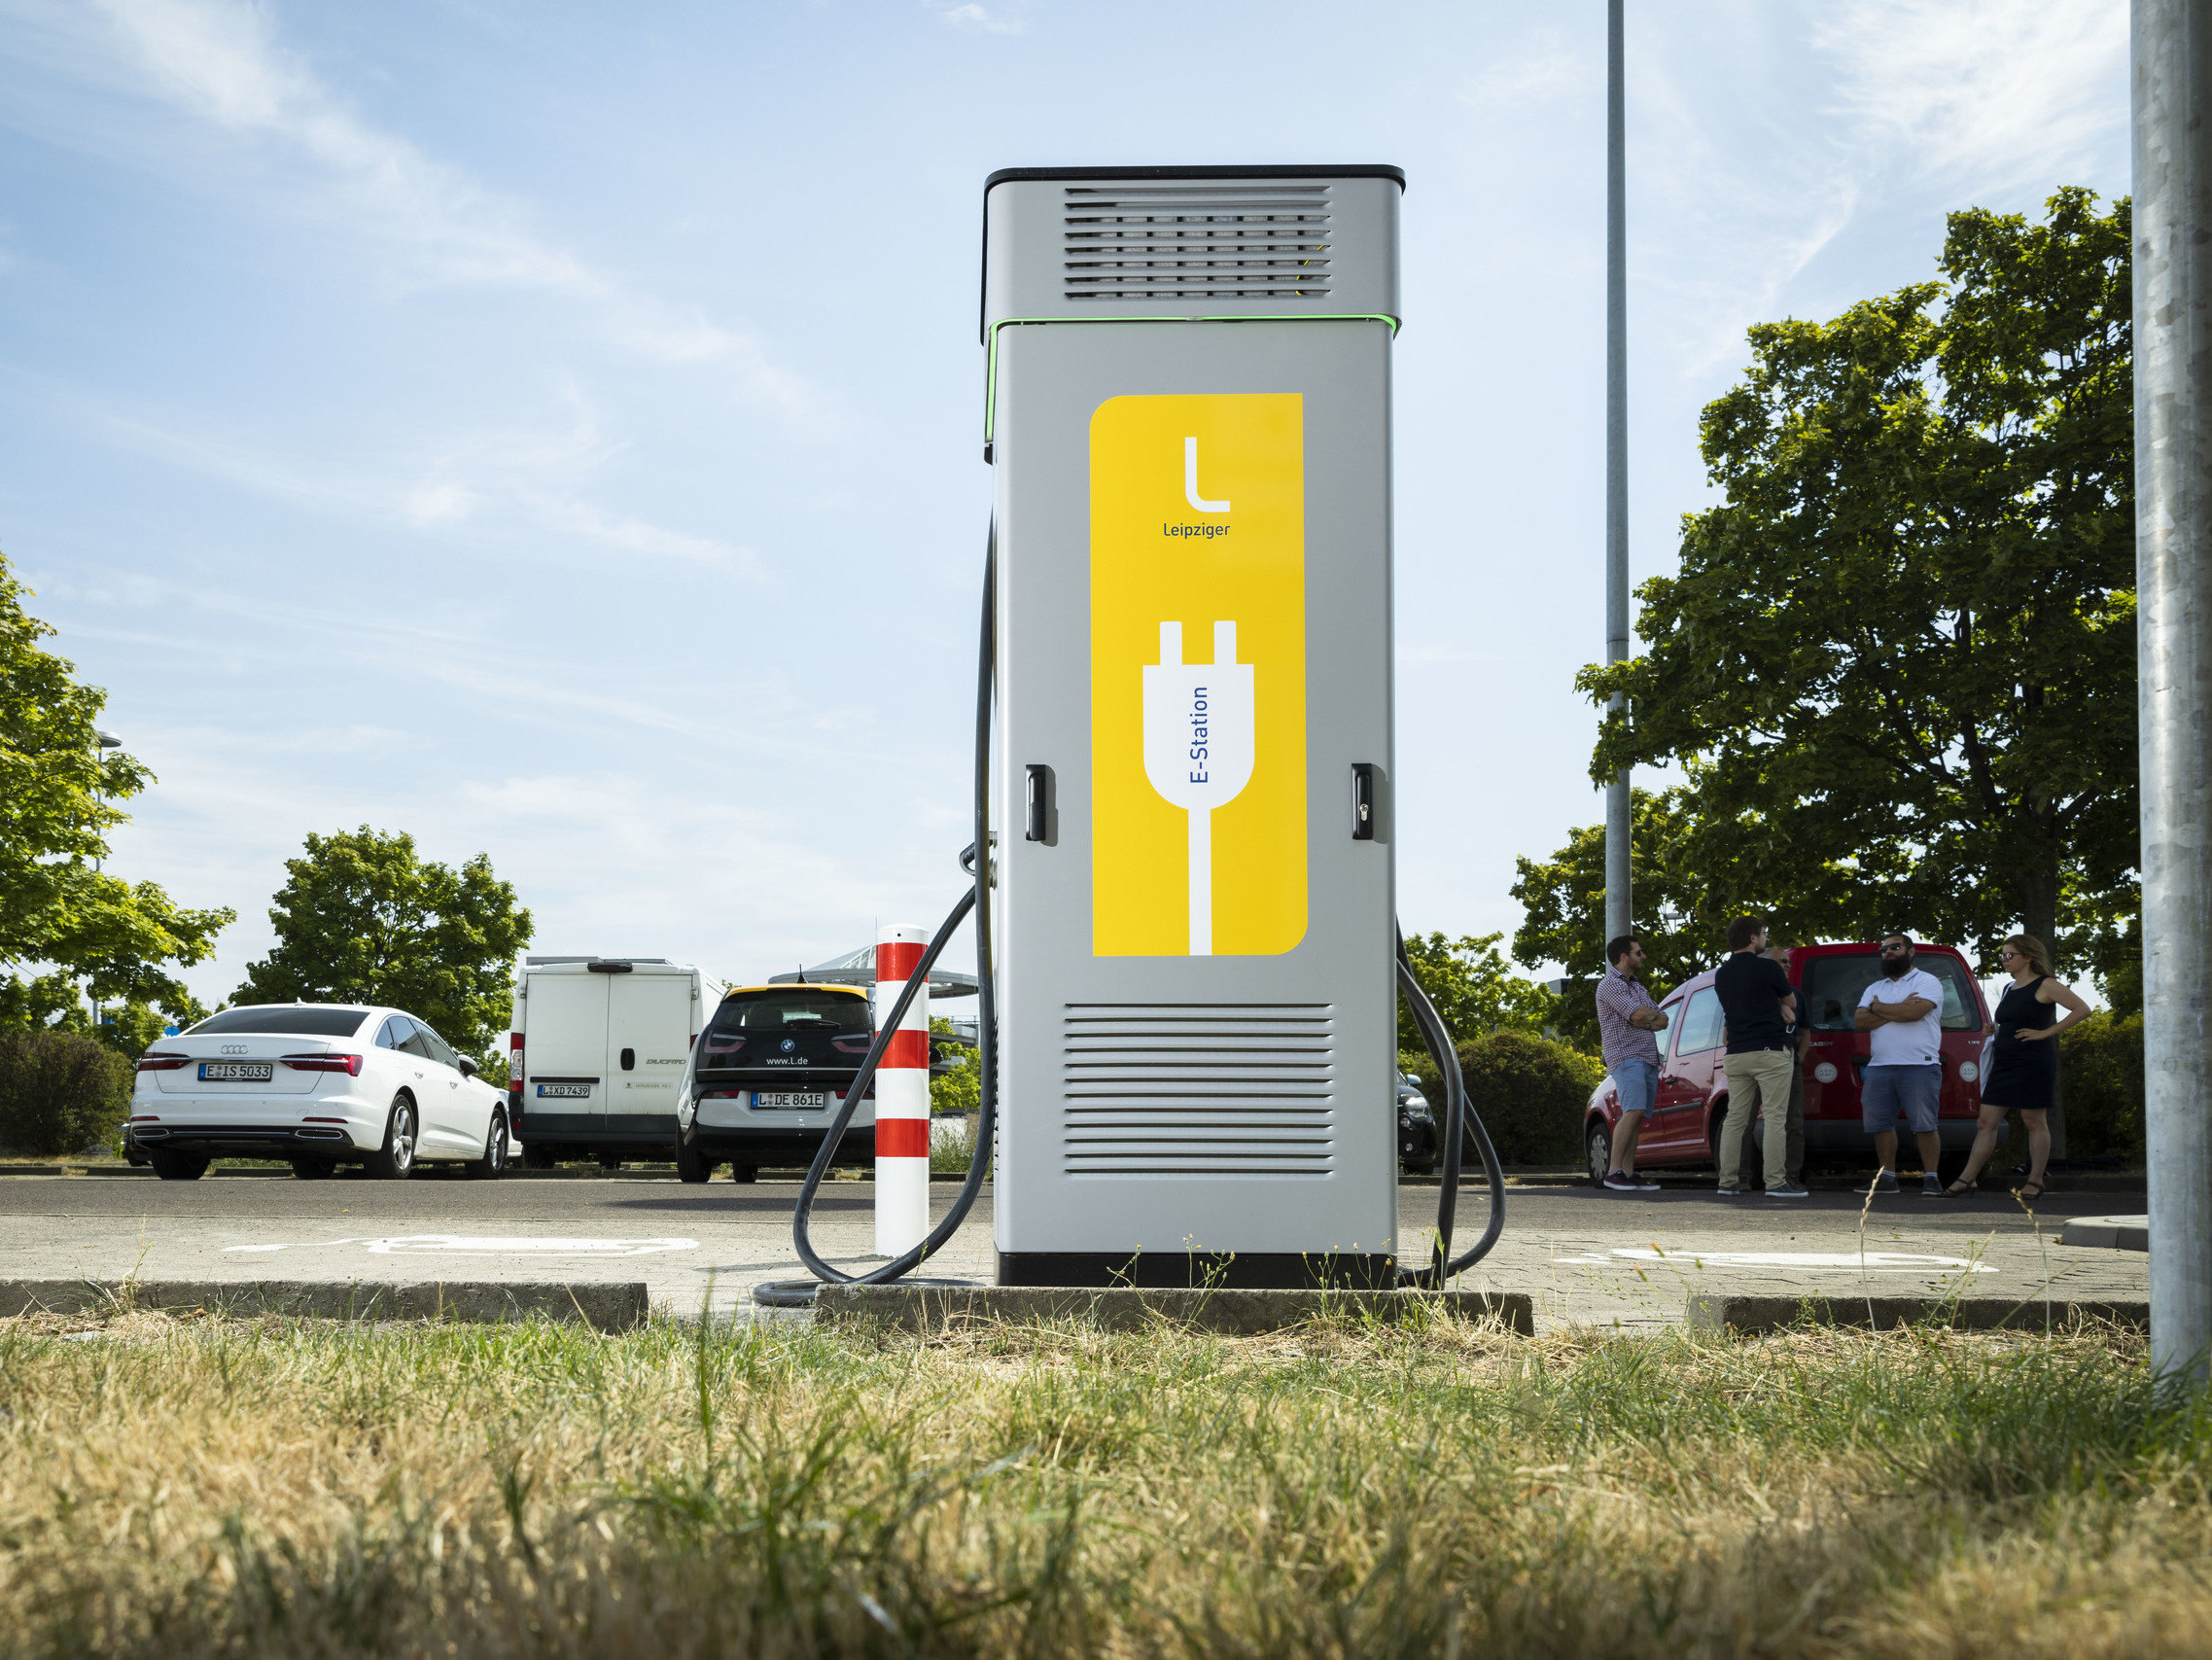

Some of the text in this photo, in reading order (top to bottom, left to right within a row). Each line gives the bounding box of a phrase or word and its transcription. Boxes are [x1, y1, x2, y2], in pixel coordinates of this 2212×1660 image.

[1184, 437, 1231, 513] L
[1163, 522, 1231, 540] Leipziger
[1189, 687, 1209, 784] E-Station
[206, 1065, 269, 1077] E IS 5033
[543, 1086, 588, 1095] L XD 7439
[758, 1094, 823, 1106] L DE 861E
